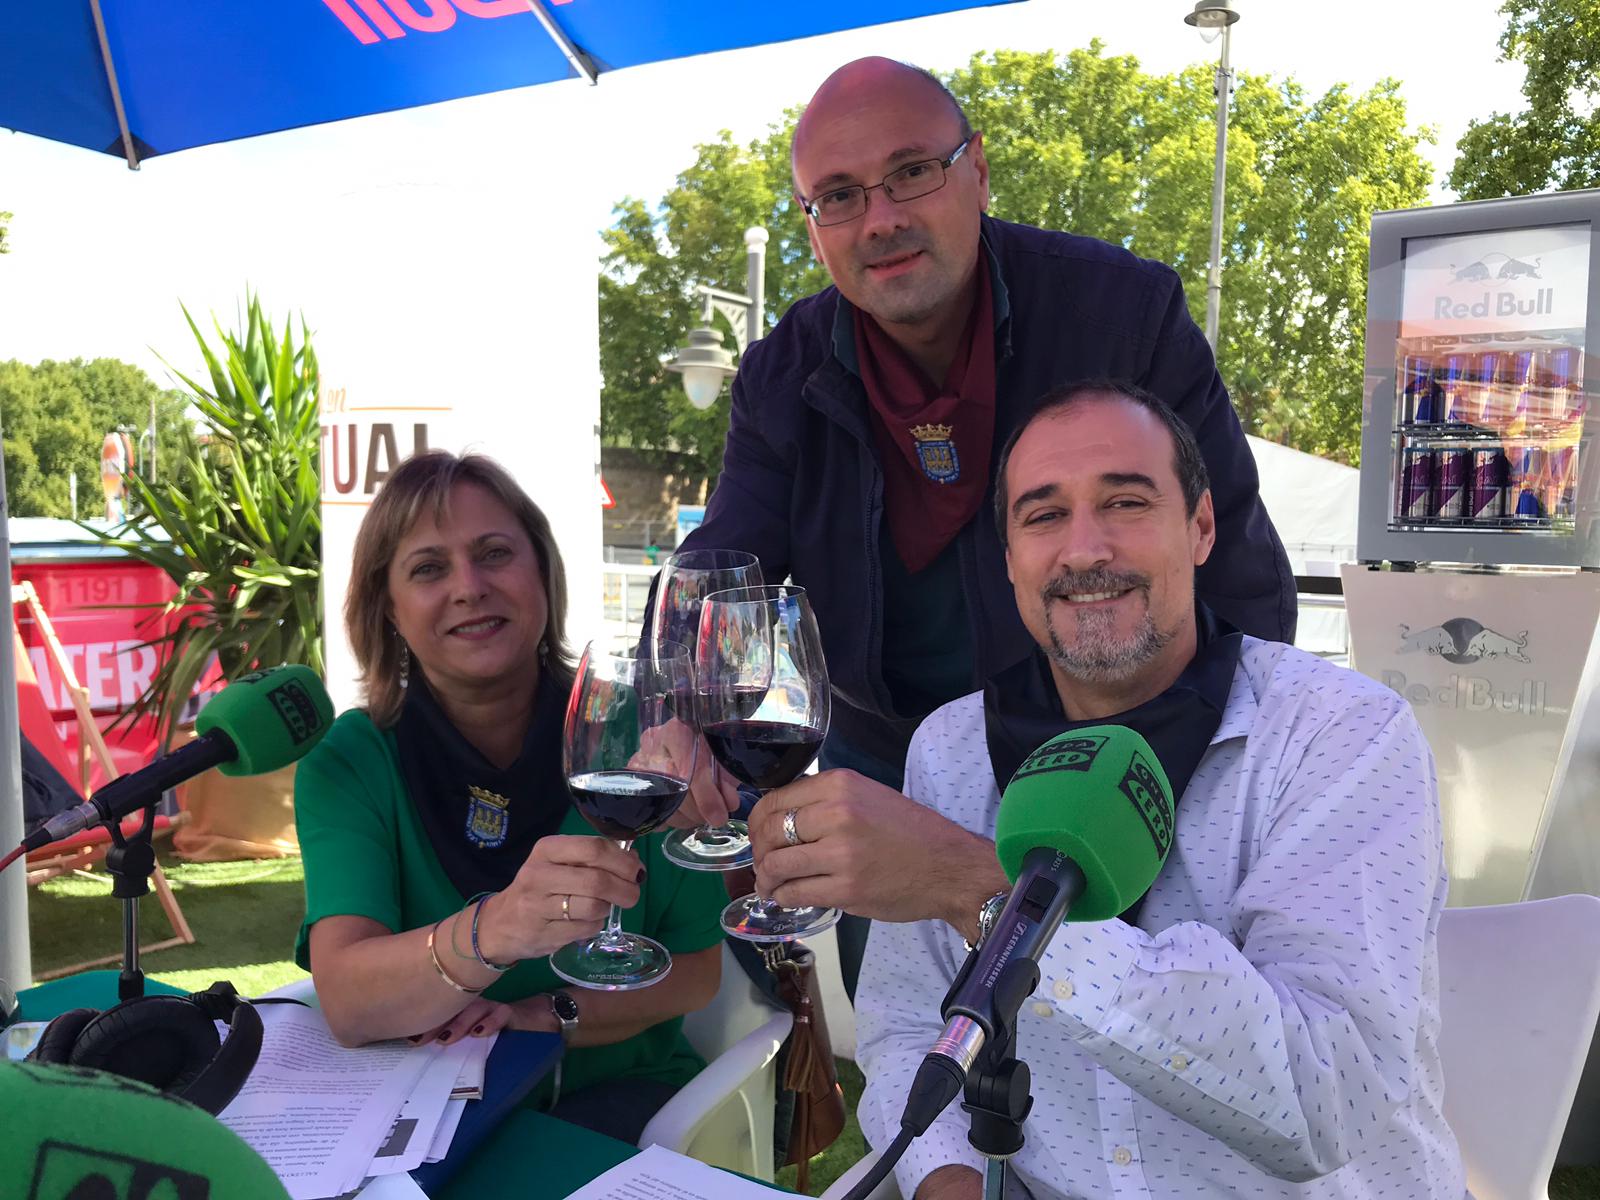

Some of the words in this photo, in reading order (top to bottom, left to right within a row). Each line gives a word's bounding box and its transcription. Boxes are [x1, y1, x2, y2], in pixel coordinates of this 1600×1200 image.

[1434, 292, 1490, 320] Red
[1495, 287, 1554, 317] Bull
[1465, 676, 1547, 717] Bull
[1022, 753, 1080, 771] CERO
[1135, 785, 1166, 841] CERO
[984, 936, 1021, 989] SENNHEISER
